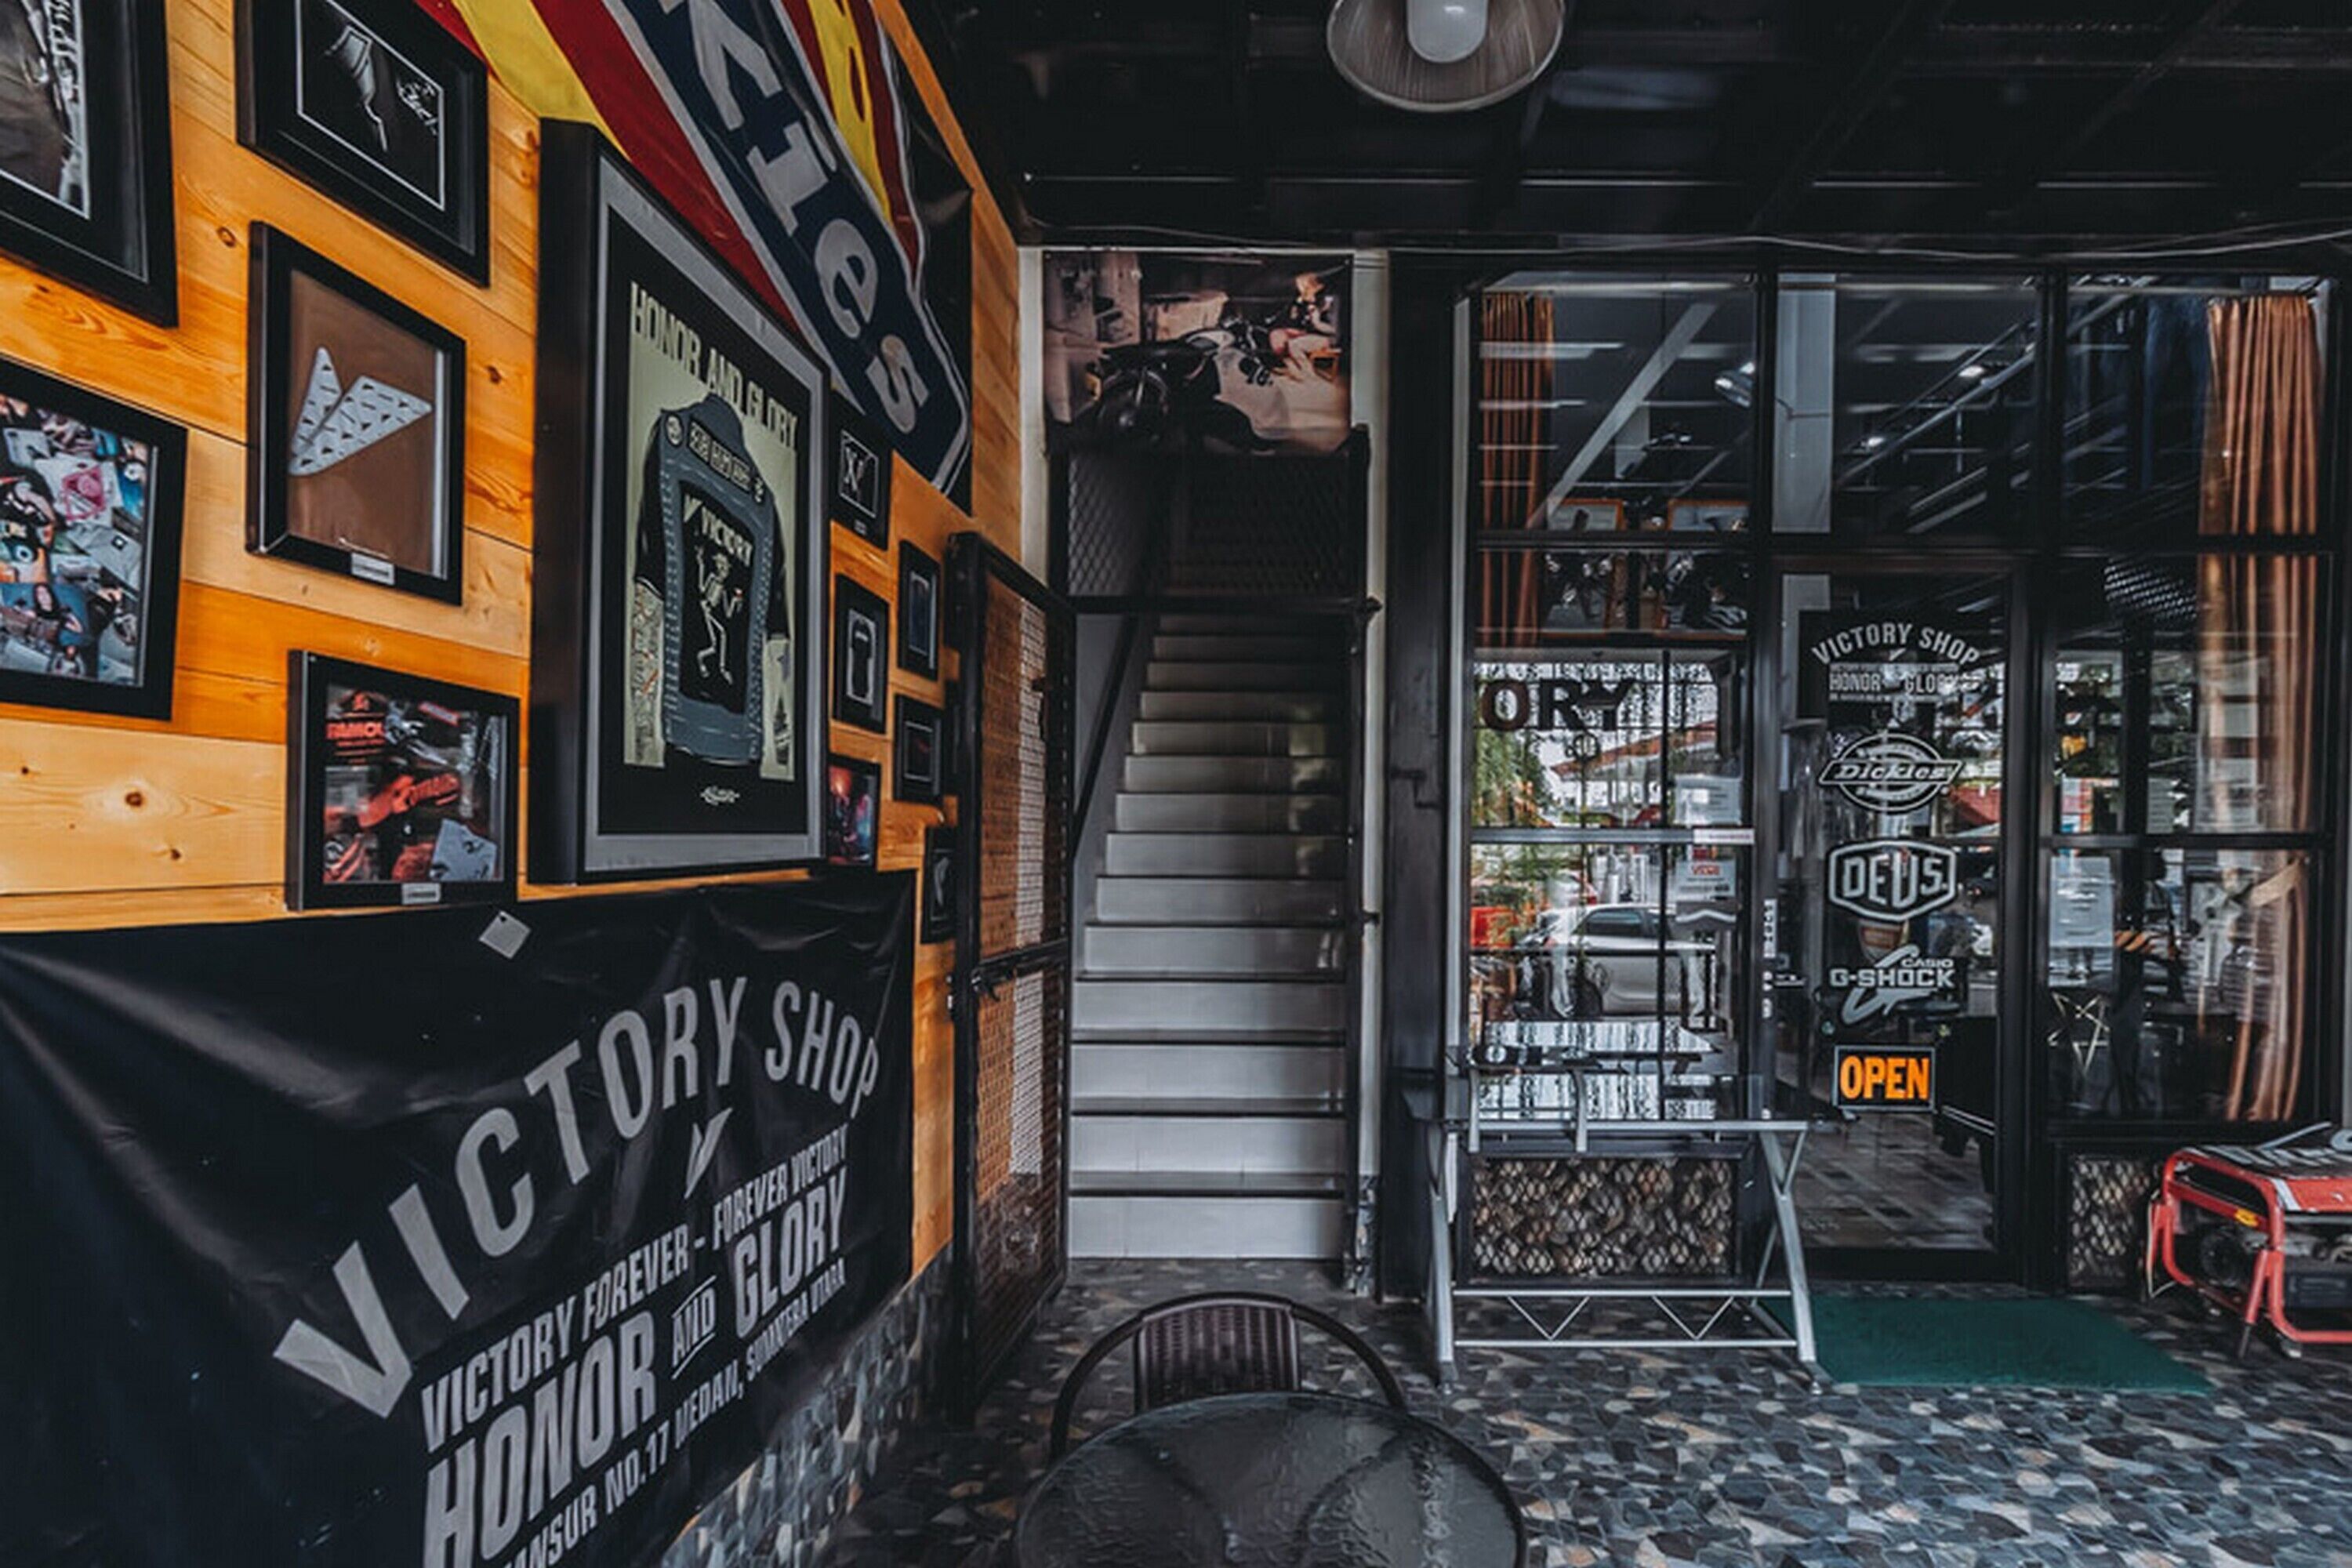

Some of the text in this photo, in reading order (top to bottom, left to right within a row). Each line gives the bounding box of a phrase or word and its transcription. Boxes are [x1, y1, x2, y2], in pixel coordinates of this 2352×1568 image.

[630, 280, 703, 384] HONOR
[706, 347, 744, 412] AND
[746, 379, 799, 453] GLORY
[1811, 622, 1980, 666] VICTORY SHOP
[1828, 673, 1881, 691] HONOR
[1833, 761, 1947, 781] Dickies
[1829, 967, 1956, 988] G-SHOCK
[1900, 957, 1955, 968] CASIO
[1840, 1055, 1929, 1100] OPEN
[272, 976, 879, 1419] VICTORY SHOP
[421, 1295, 576, 1453] VICTORY
[582, 1223, 688, 1341] FOREVER
[712, 1163, 787, 1250] FOREVER
[790, 1122, 848, 1195] VICTORY
[423, 1165, 848, 1568] HONOR AND GLORY
[675, 1359, 742, 1449] MEDAN,
